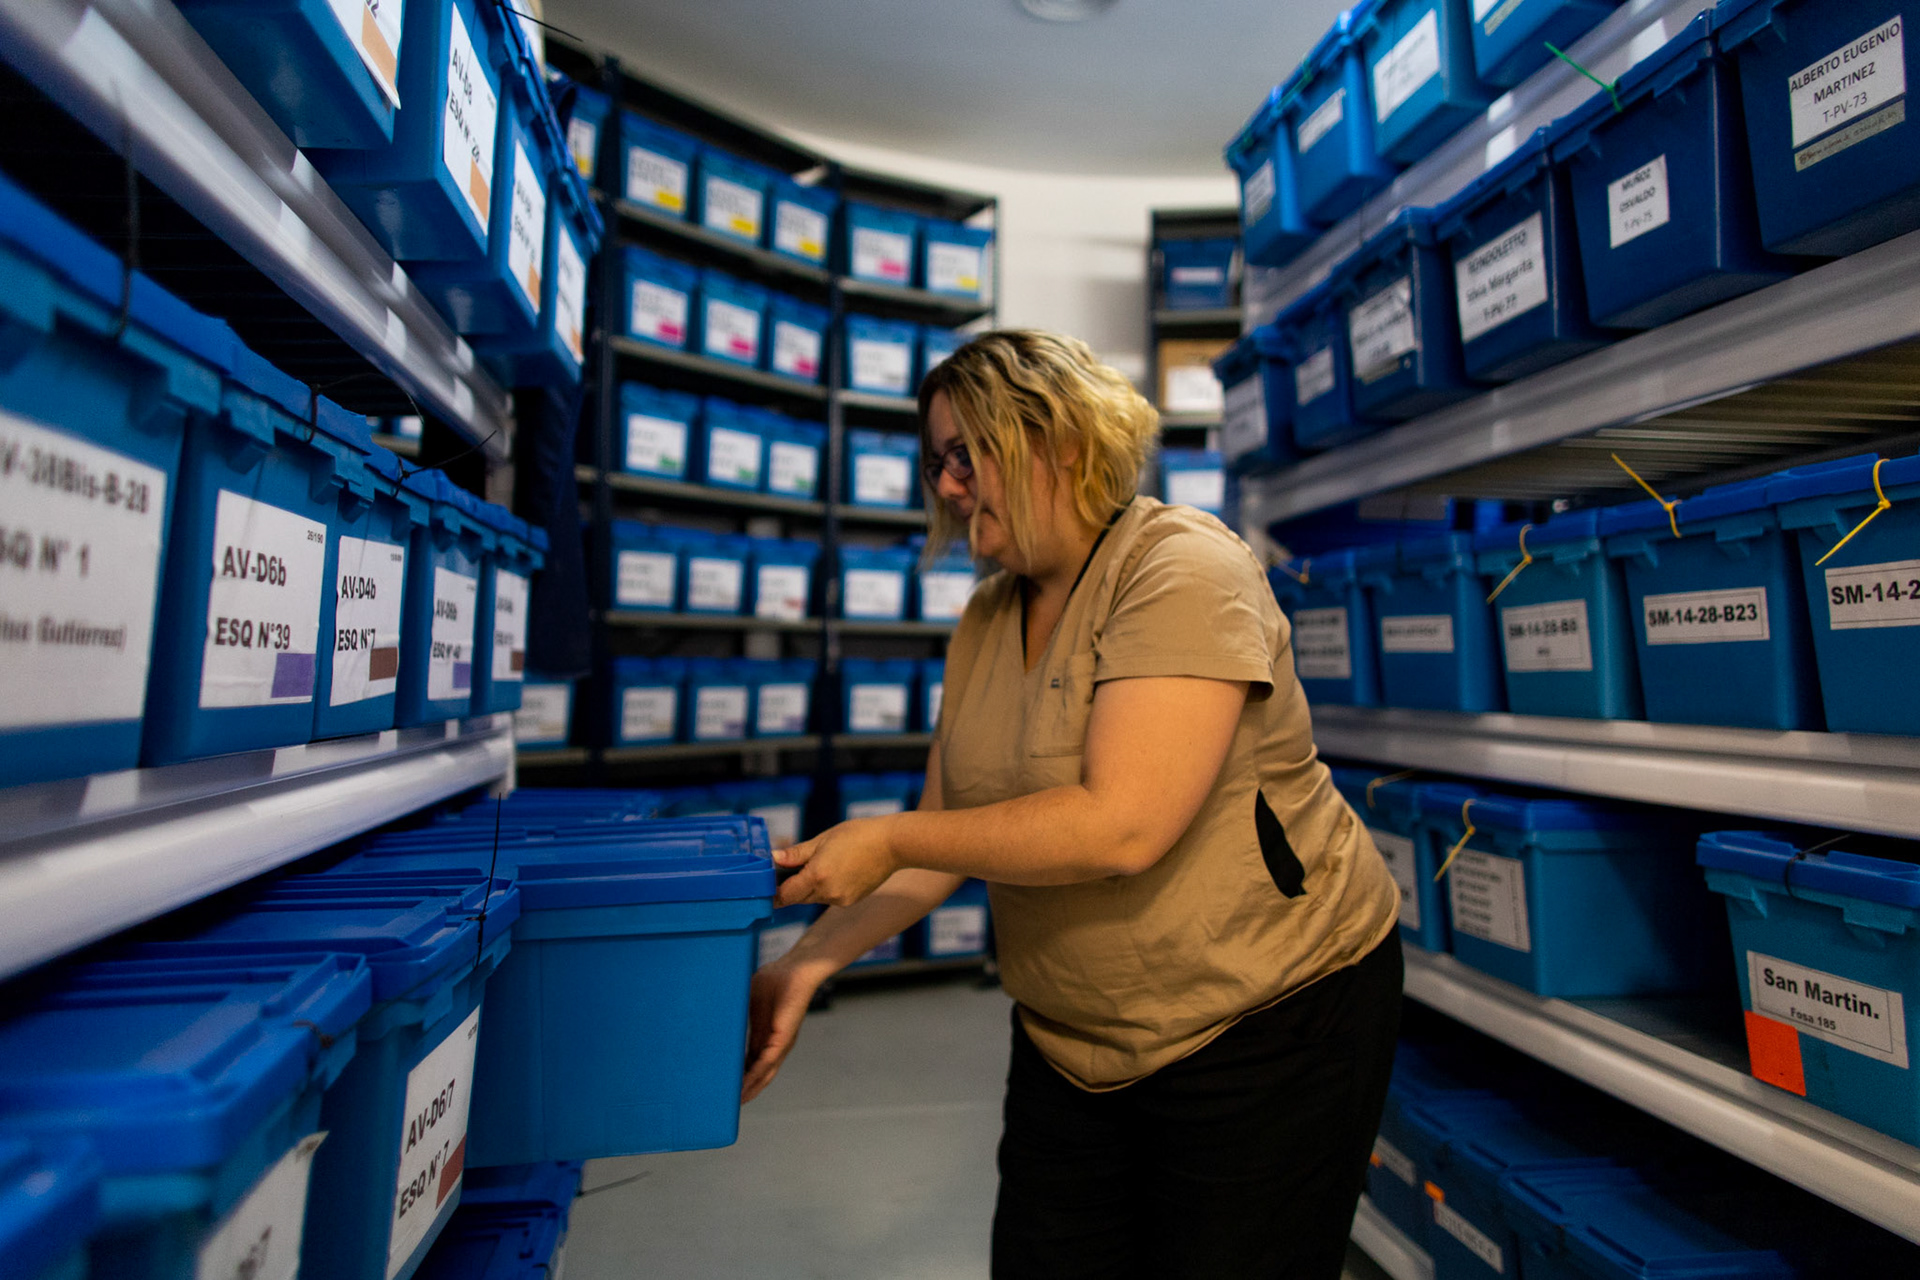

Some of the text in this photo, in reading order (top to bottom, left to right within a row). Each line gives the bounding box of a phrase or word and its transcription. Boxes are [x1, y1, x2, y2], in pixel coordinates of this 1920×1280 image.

[1790, 22, 1900, 93] ALBERTO EUGENIO
[1813, 61, 1876, 104] MARTINEZ
[1822, 91, 1868, 123] T-PV-73
[79, 541, 90, 580] 1
[222, 545, 287, 587] AV-D6b
[341, 575, 376, 600] AV-D4b
[214, 617, 254, 649] ESQ
[1648, 603, 1758, 627] SM-14-28-B23
[337, 628, 358, 652] ESQ
[1763, 967, 1880, 1020] San Martin.
[1790, 1006, 1837, 1031] Fosa 185
[405, 1078, 456, 1154] AV-D6/7
[398, 1169, 427, 1220] ESQ
